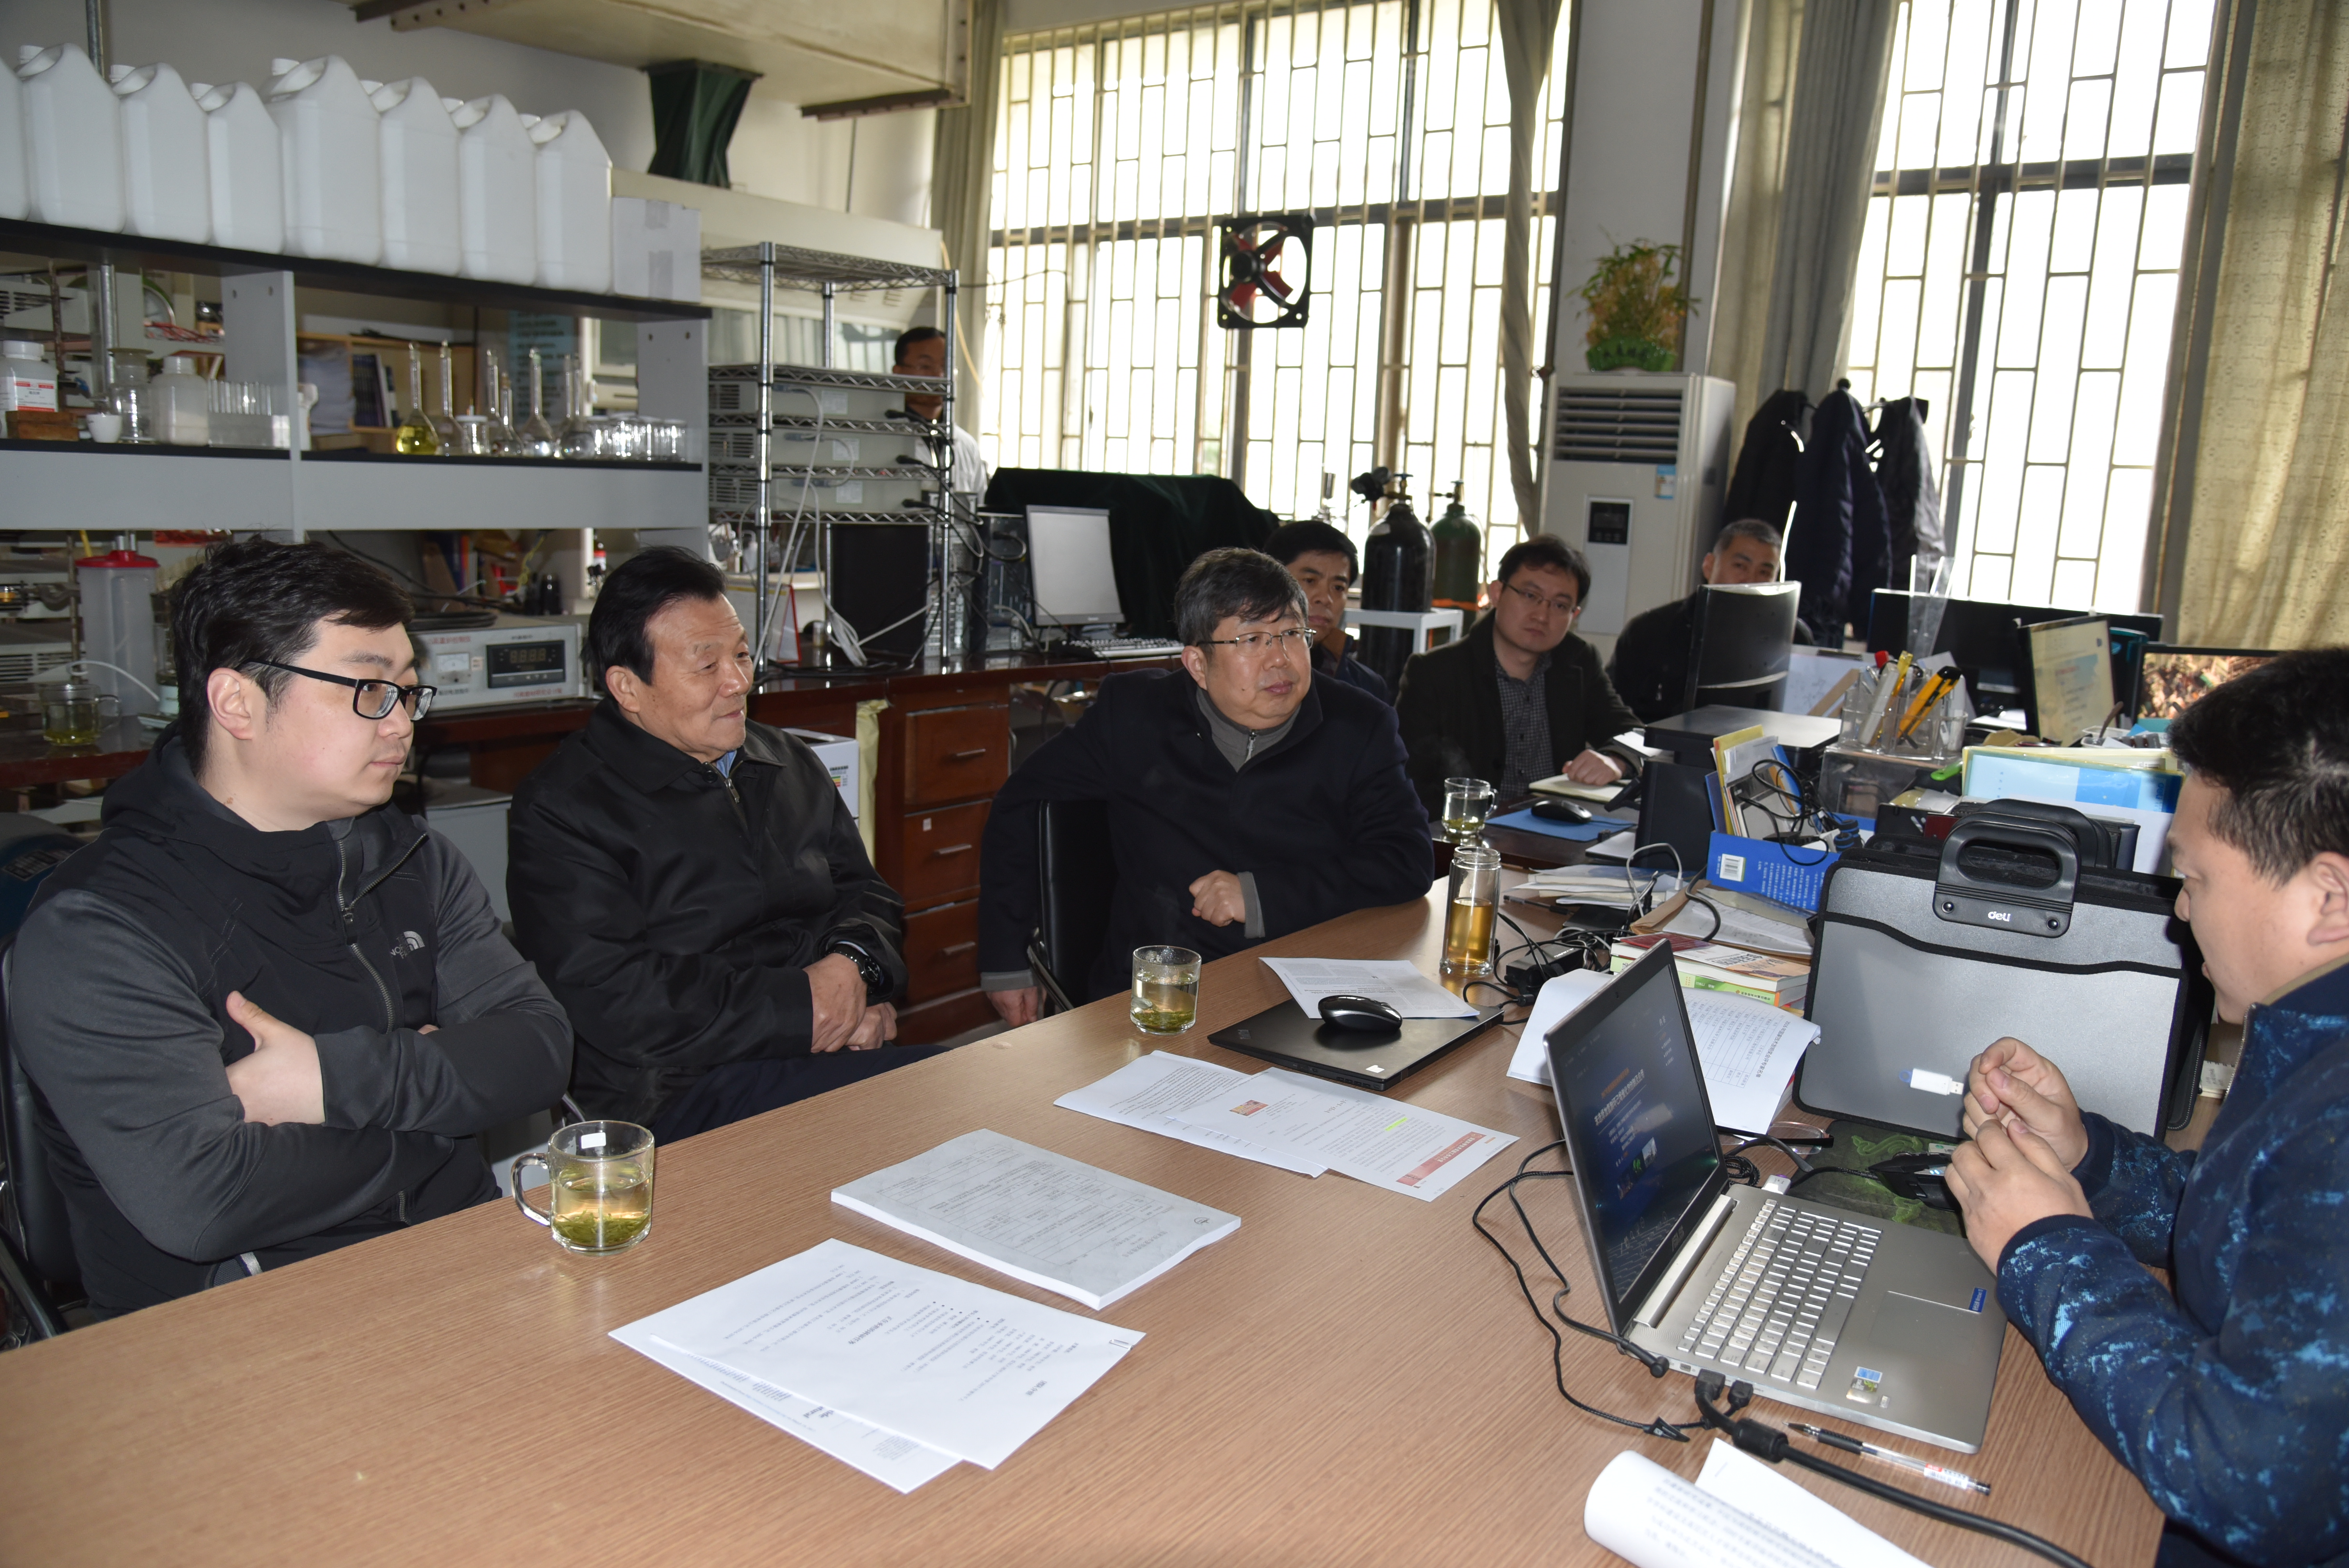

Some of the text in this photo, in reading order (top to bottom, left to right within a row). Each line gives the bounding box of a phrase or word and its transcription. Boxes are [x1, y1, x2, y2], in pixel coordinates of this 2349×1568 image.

[1988, 911, 2010, 921] deli
[1741, 991, 1771, 1000] 科学技术文献出版社
[1755, 1027, 1786, 1078] 年国家技术发明奖会评专家名单
[1435, 1137, 1476, 1162] 国家科学技术奖励工作办公室
[846, 1316, 894, 1344] 正在承担的科研任务
[1025, 1380, 1048, 1395] 团队介绍
